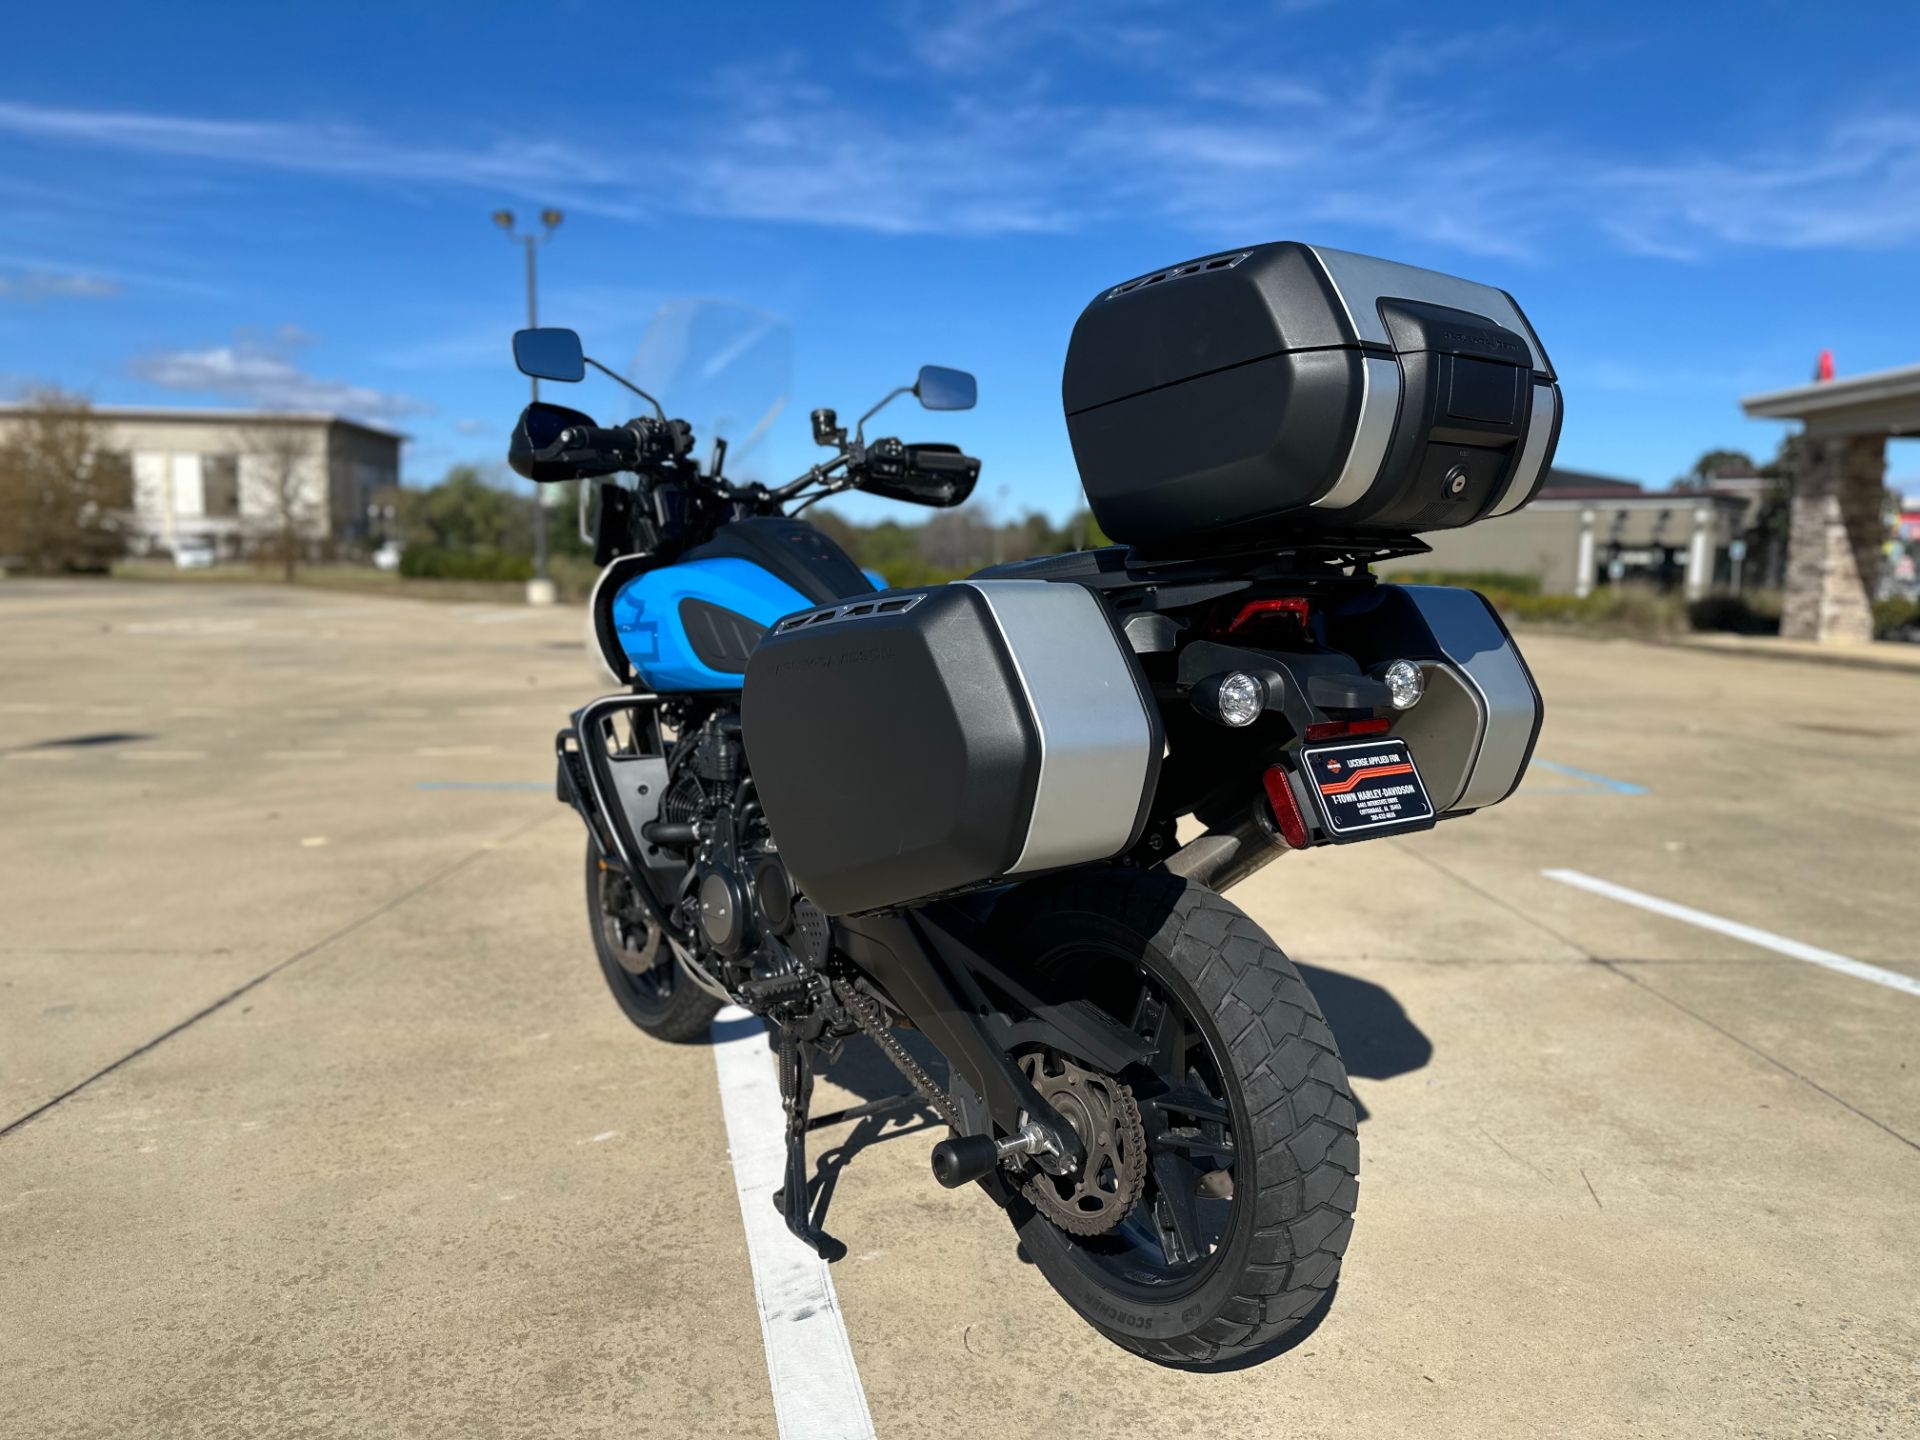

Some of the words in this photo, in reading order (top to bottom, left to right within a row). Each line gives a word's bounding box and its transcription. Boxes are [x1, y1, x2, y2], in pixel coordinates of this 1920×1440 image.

[1347, 757, 1369, 768] LICENSE
[1369, 755, 1389, 766] APPLIED
[1389, 754, 1400, 763] FOR
[1331, 792, 1357, 804] T-TOWN
[1357, 784, 1415, 800] HARLEY-DAVIDSON
